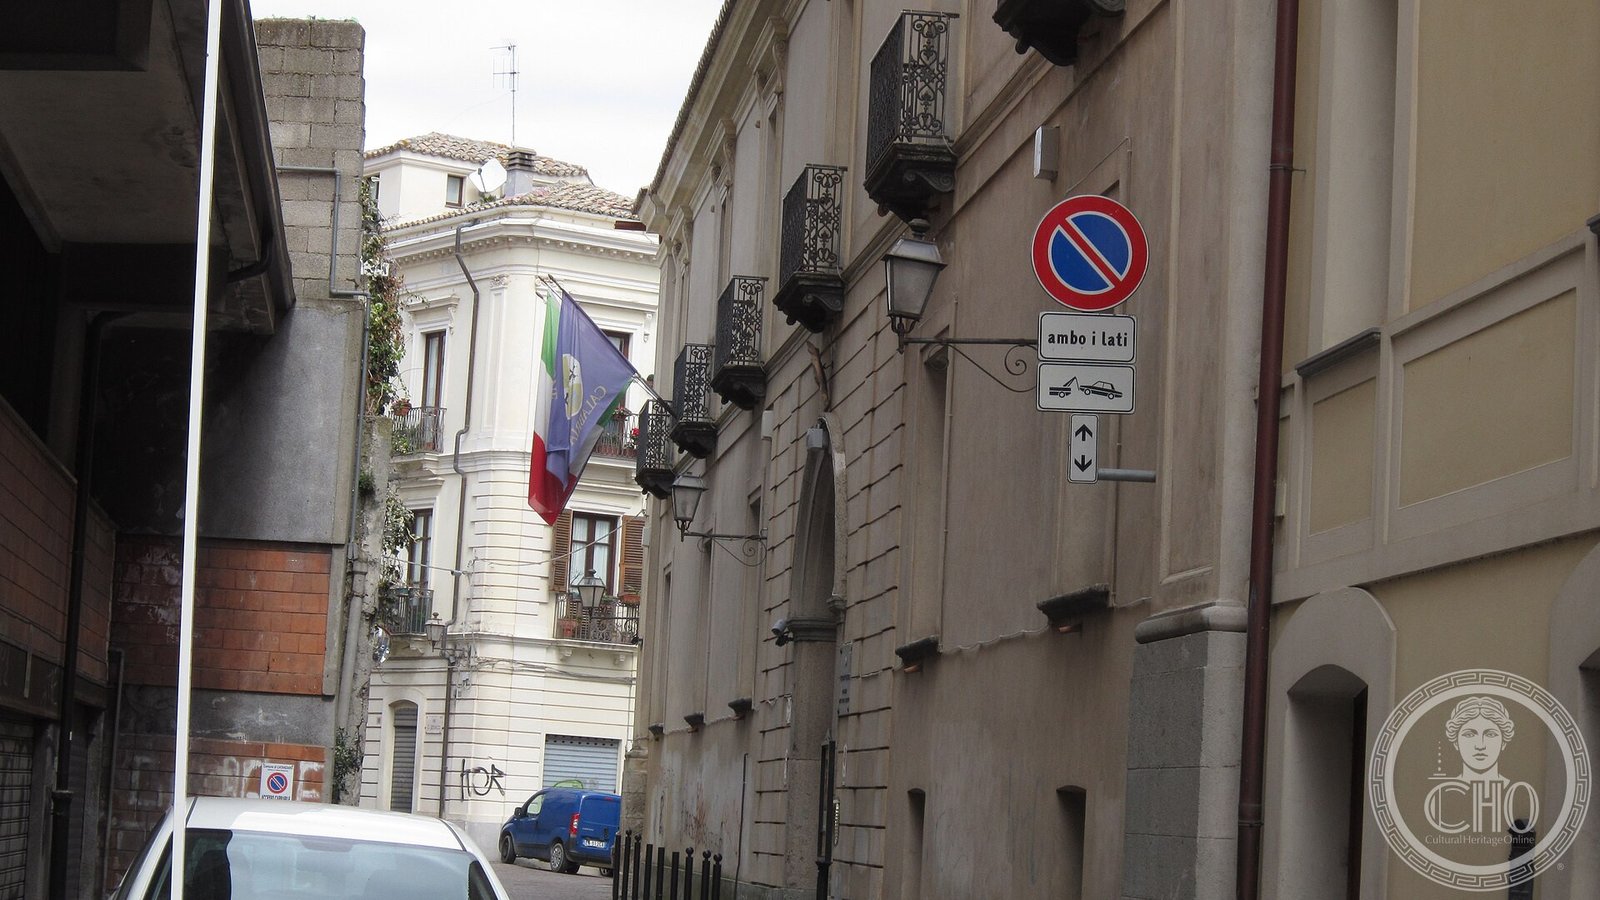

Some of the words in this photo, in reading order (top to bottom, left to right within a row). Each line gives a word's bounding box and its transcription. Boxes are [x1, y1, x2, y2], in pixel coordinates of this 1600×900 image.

[1048, 330, 1087, 345] ambo
[1092, 331, 1096, 346] i
[1102, 331, 1128, 347] lati
